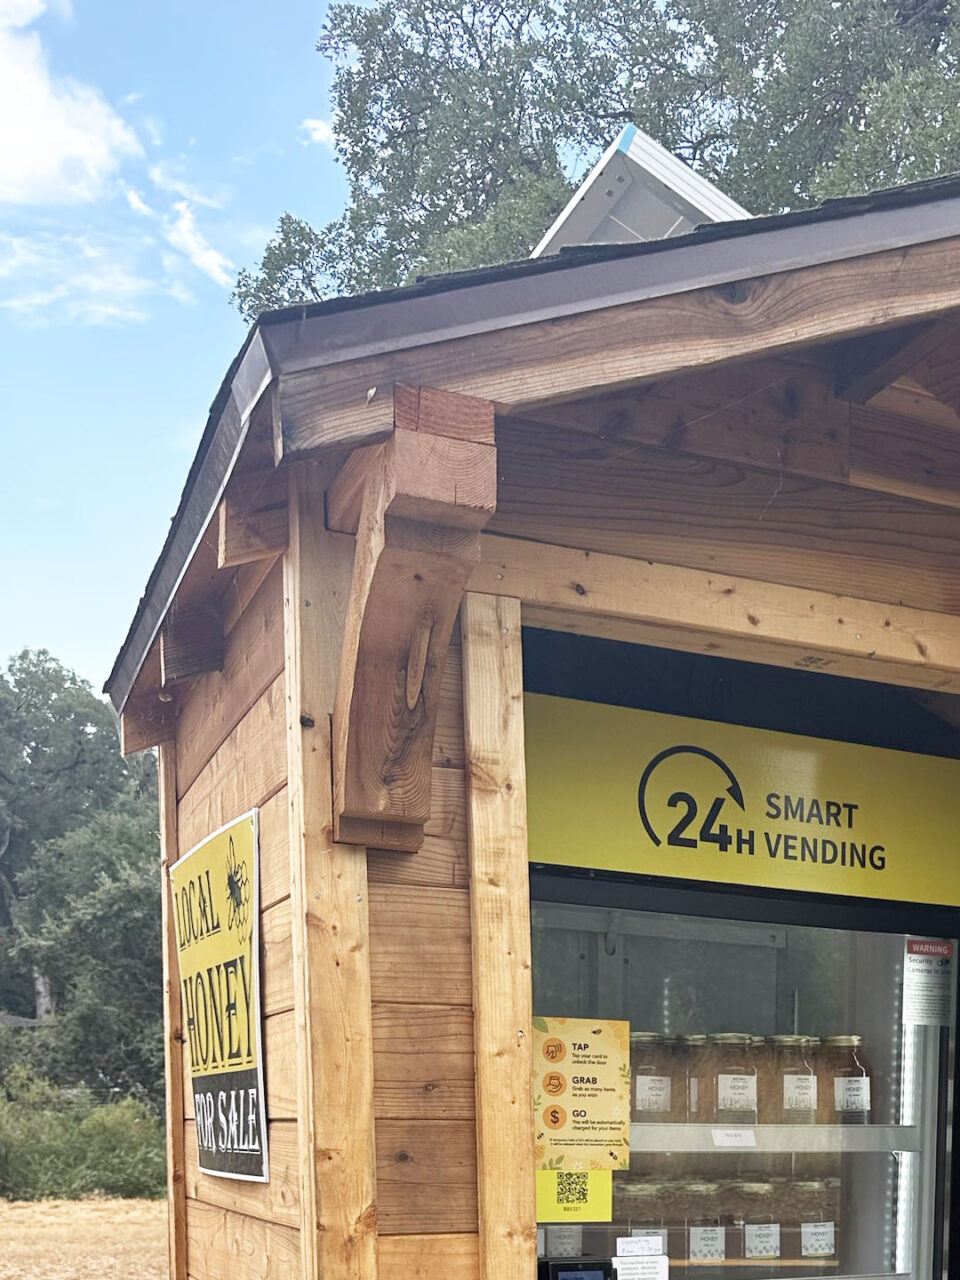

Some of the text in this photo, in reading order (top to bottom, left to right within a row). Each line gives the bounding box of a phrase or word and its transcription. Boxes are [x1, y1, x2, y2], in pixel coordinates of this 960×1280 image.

[667, 791, 755, 855] 24H
[765, 792, 859, 829] SMART
[764, 831, 886, 871] VENDING
[174, 870, 221, 952] LOCAL
[908, 956, 933, 966] Security
[912, 943, 949, 955] WARNING
[183, 926, 253, 1072] HONEY
[571, 1042, 590, 1051] TAP
[571, 1076, 598, 1085] GRAB
[194, 1088, 260, 1157] FOR SALE
[571, 1109, 587, 1118] GO
